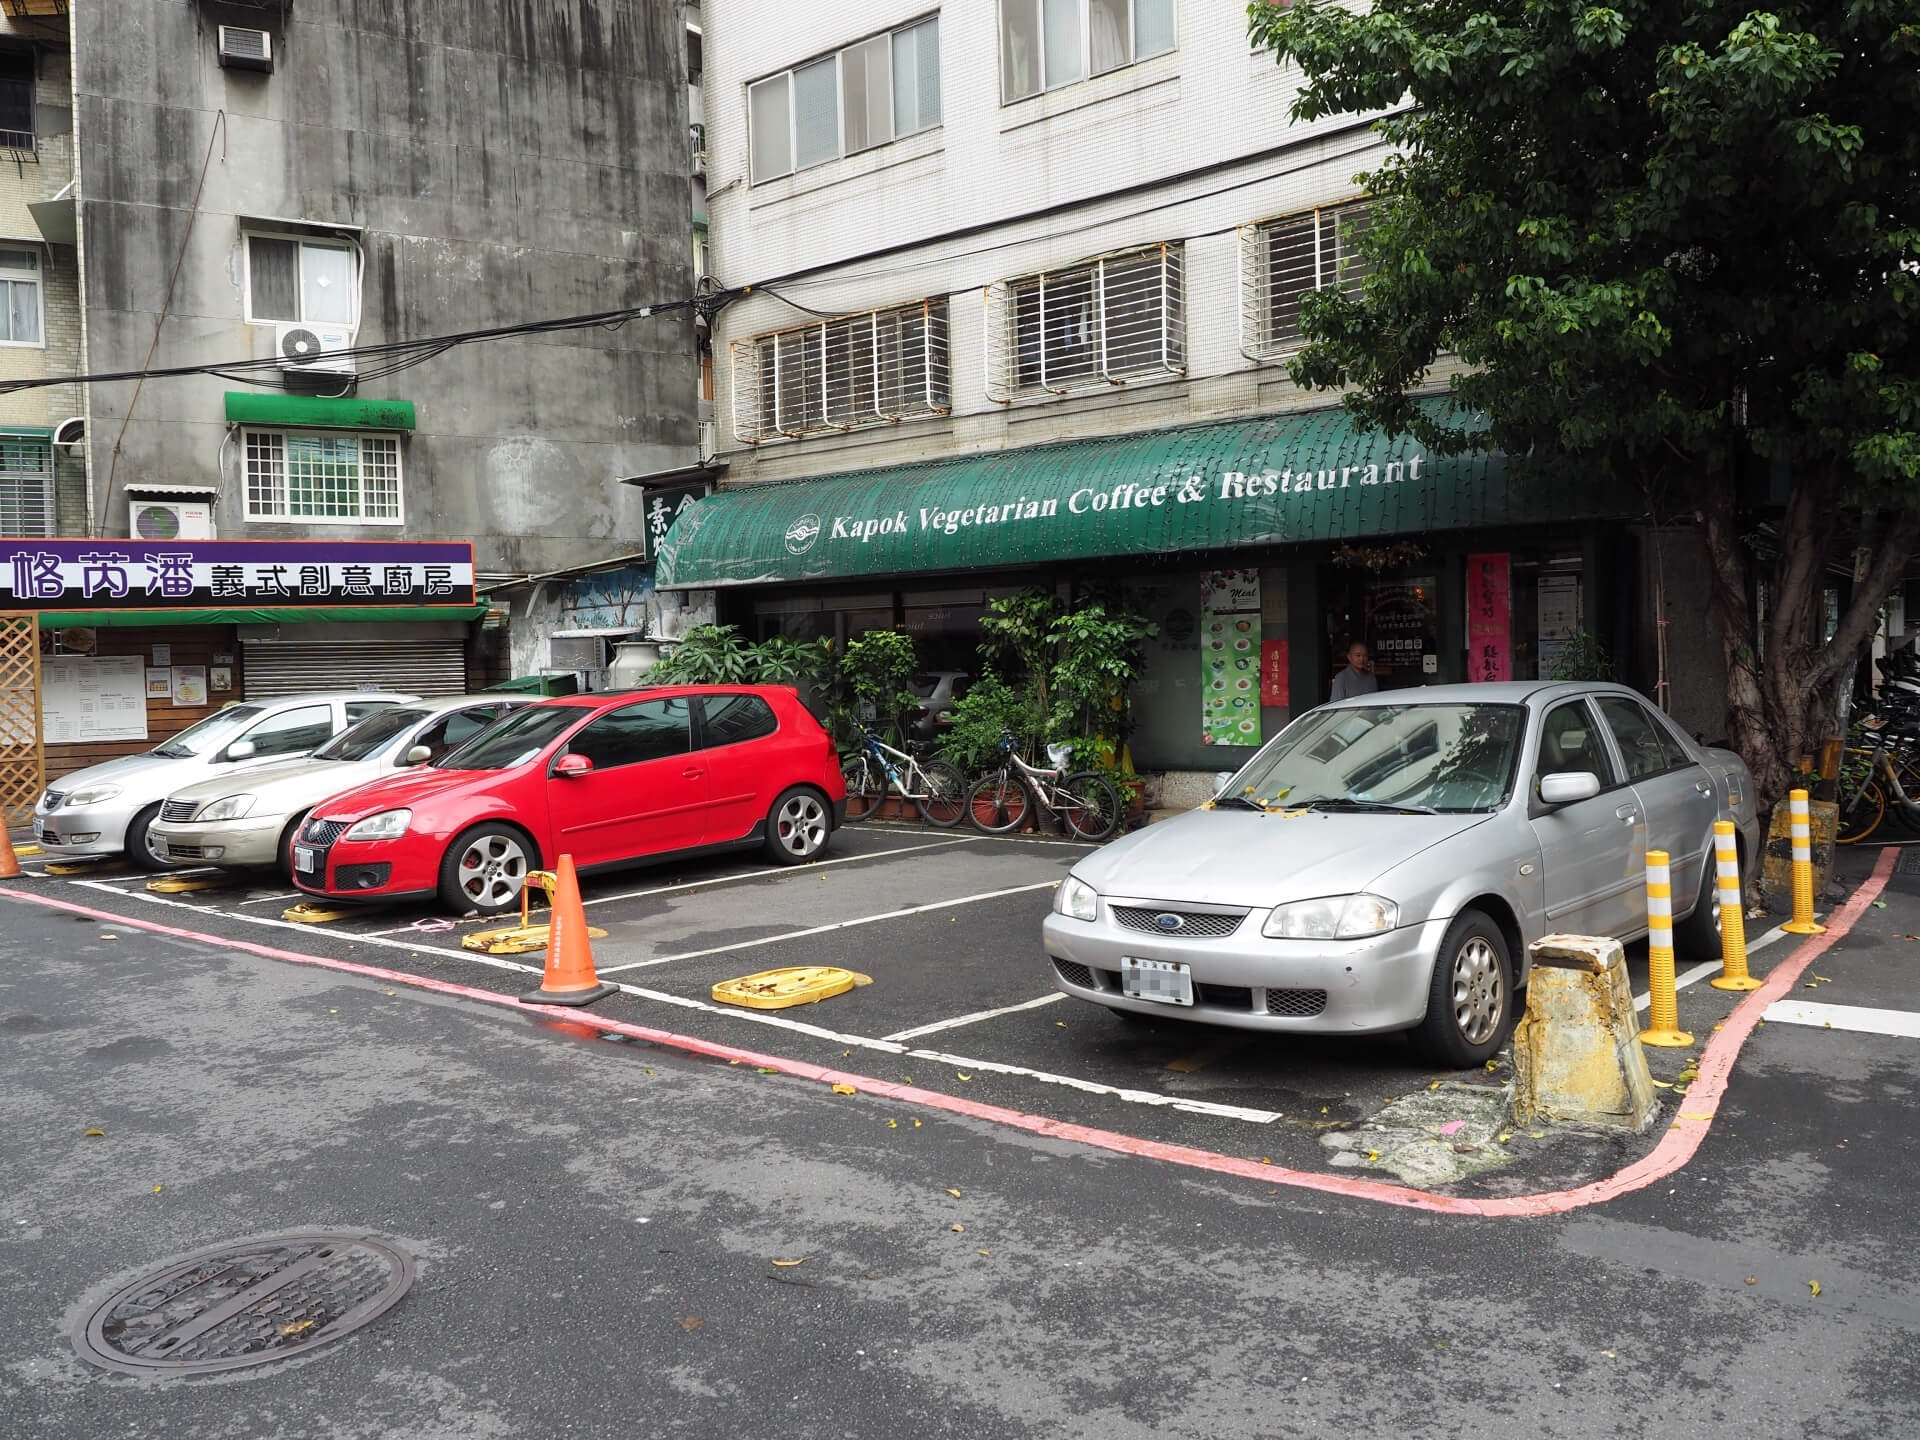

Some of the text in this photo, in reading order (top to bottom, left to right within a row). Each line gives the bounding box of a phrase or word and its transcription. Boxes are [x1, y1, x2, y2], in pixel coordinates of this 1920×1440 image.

[828, 511, 909, 543] Kapok
[919, 496, 1058, 535] Vegetarian
[1068, 483, 1167, 515] Coffee
[1176, 475, 1206, 503] &
[1218, 453, 1425, 500] Restaurant
[10, 551, 454, 599] 格芮潘 義式創意廚房
